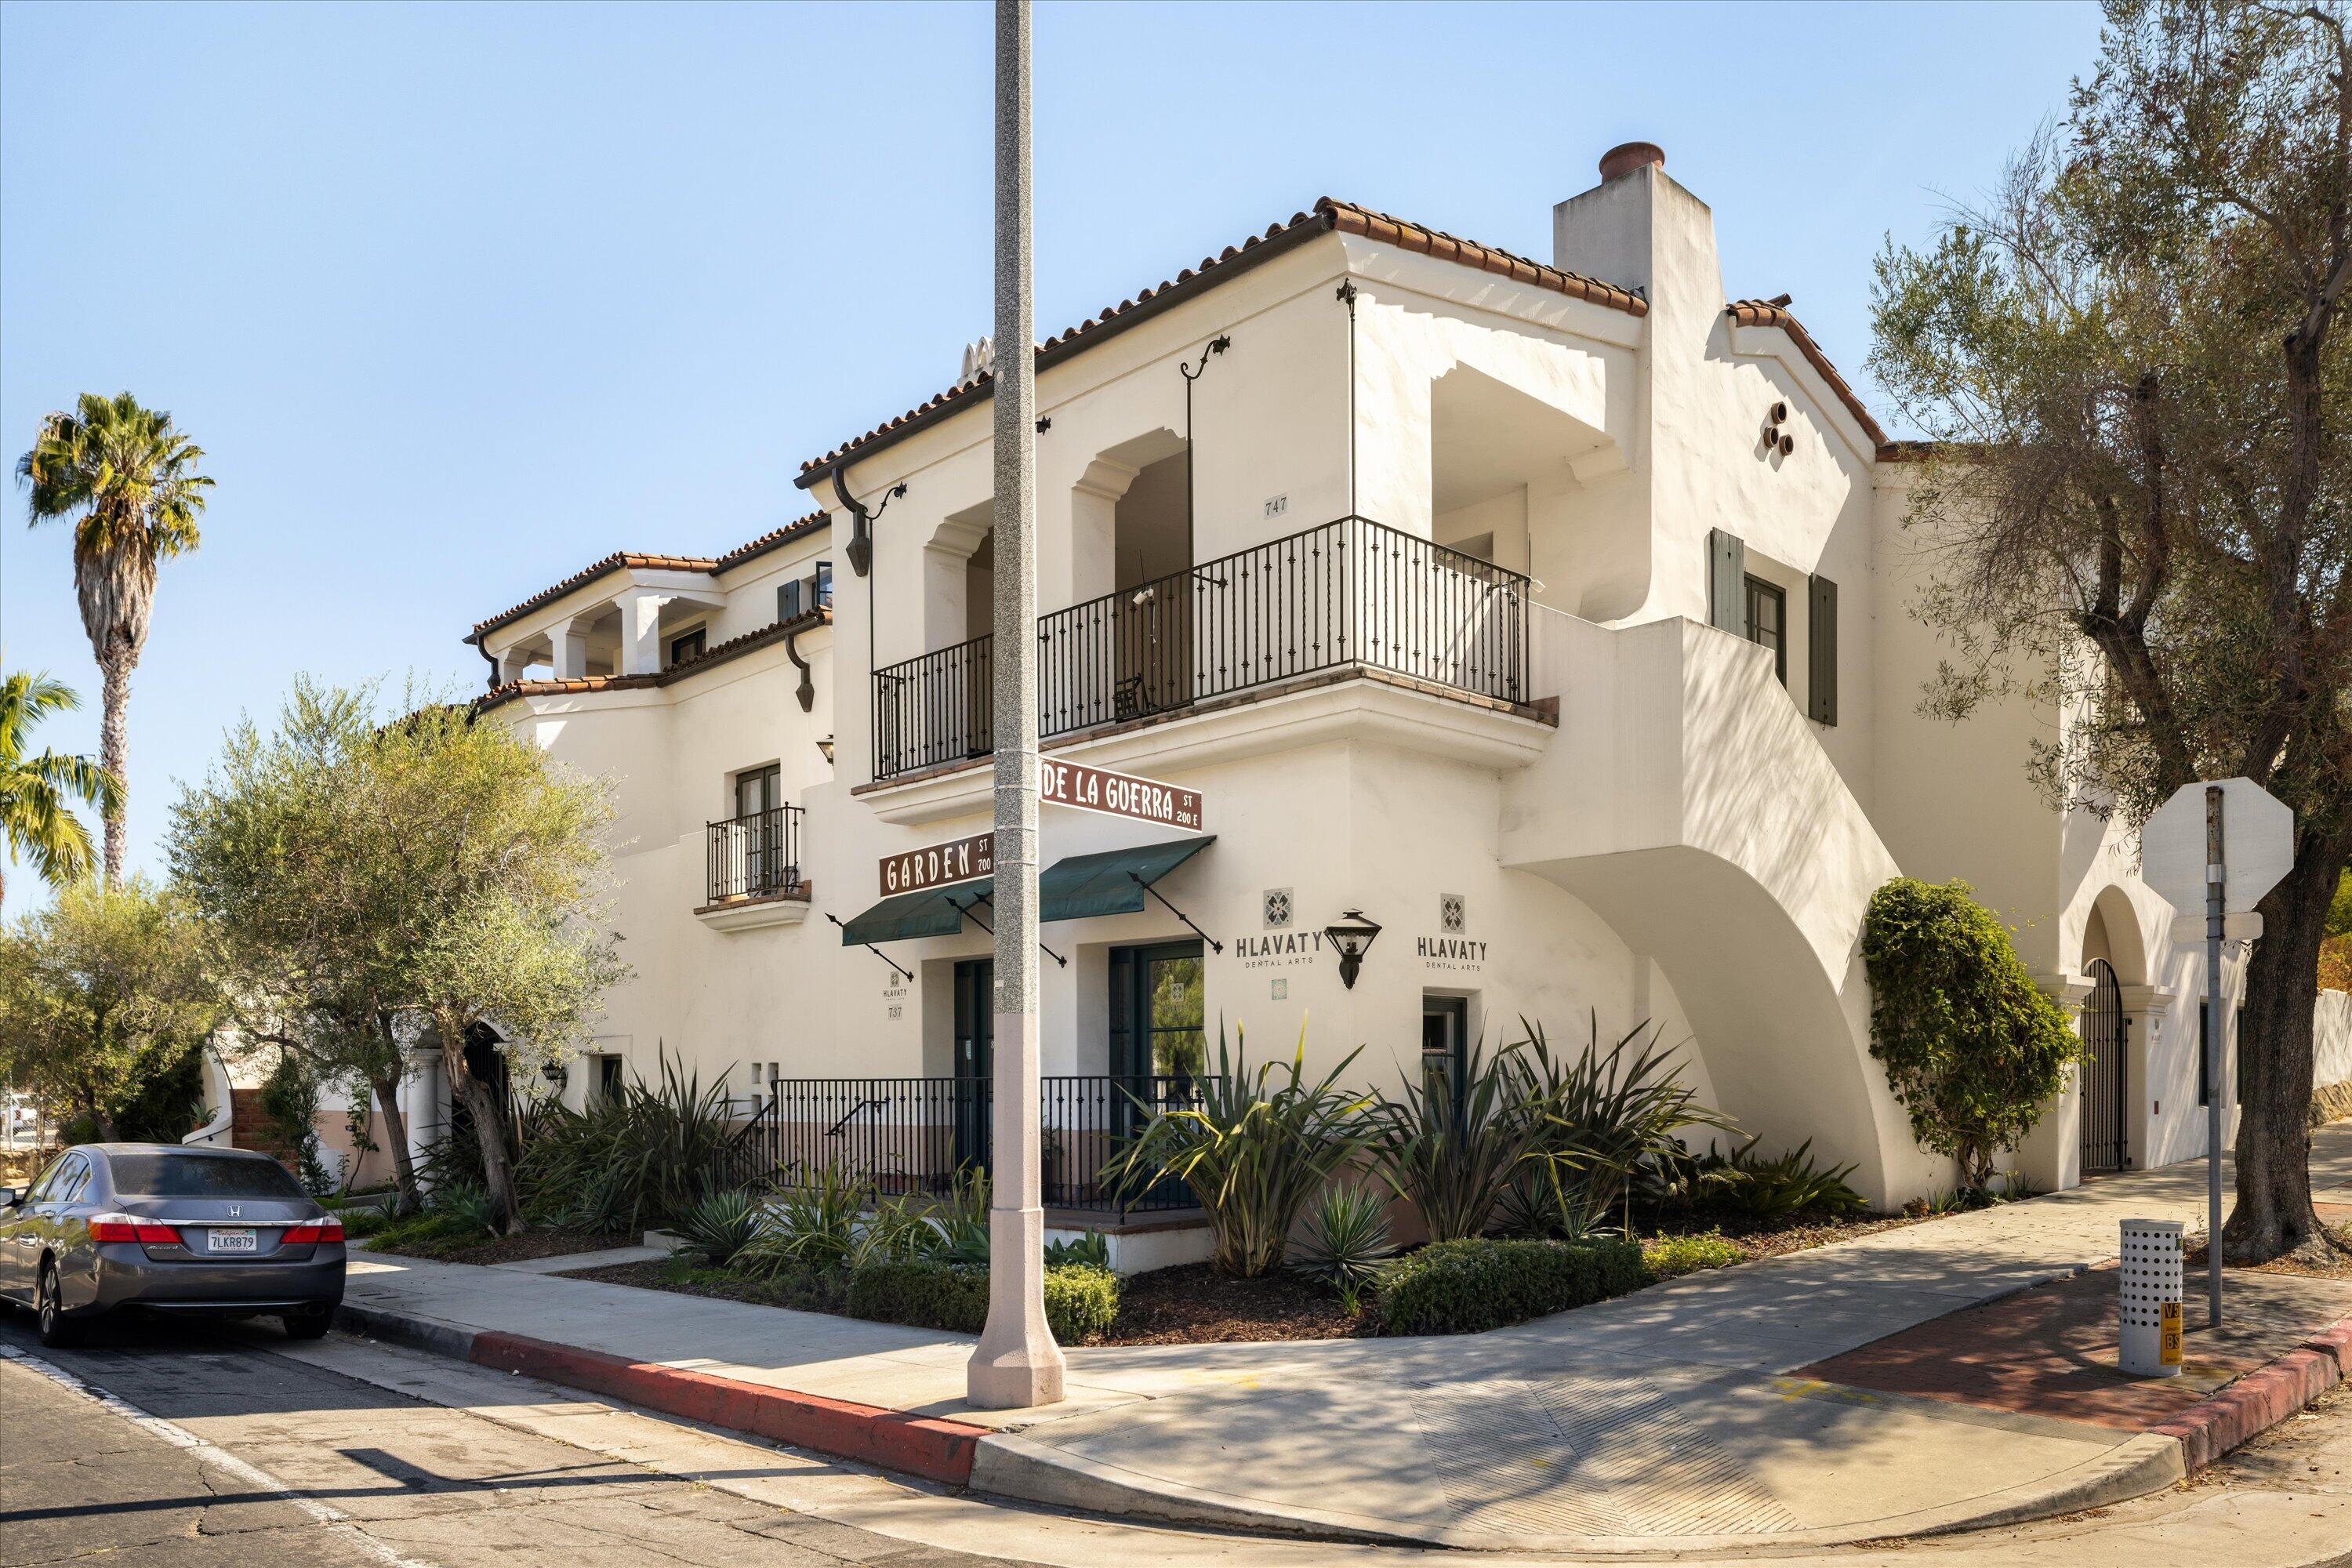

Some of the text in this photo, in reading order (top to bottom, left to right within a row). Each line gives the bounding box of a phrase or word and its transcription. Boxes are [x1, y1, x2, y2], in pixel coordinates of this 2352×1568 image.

[1265, 496, 1287, 516] 747
[1043, 763, 1192, 821] DE LA GUERRA ST
[1176, 811, 1198, 826] 200 E
[887, 838, 988, 891] GARDEN ST
[1236, 931, 1323, 958] HLAVATY
[1417, 936, 1486, 961] HLAVATY
[1245, 960, 1282, 968] DENTAL
[1426, 961, 1456, 970] DENTAL
[883, 989, 907, 998] HLAVATY
[888, 1007, 902, 1018] 737
[212, 1237, 254, 1247] 7LKR879
